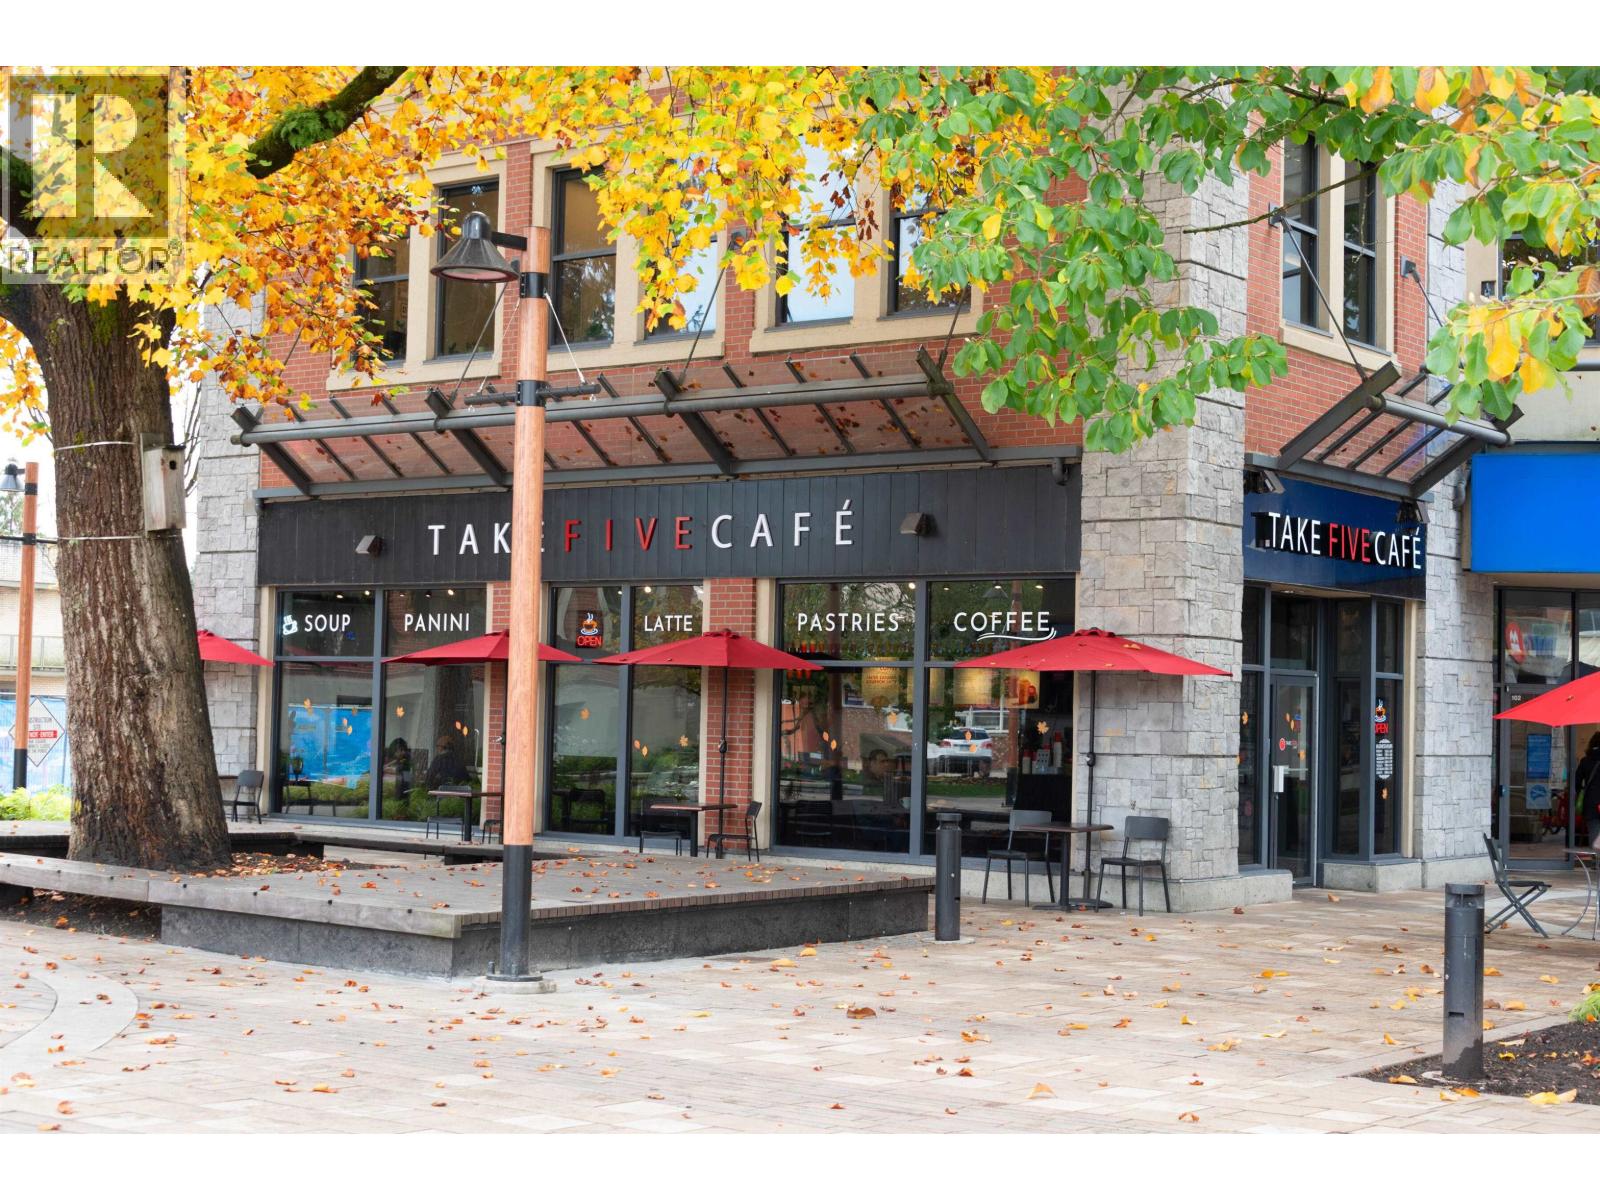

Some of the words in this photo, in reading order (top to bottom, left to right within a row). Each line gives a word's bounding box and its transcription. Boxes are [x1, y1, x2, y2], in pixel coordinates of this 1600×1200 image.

[427, 521, 545, 556] TAK
[564, 516, 693, 552] FIVE
[711, 498, 854, 549] CAFÉ
[1268, 511, 1321, 556] TAKE
[1328, 522, 1371, 563] FIVE
[1374, 526, 1421, 569] CAFÉ
[304, 614, 351, 632] SOUP
[403, 613, 470, 632] PANINI
[644, 614, 693, 632] LATTE
[797, 613, 899, 632] PASTRIES
[953, 611, 1051, 633] COFFEE
[577, 635, 602, 646] OPEN
